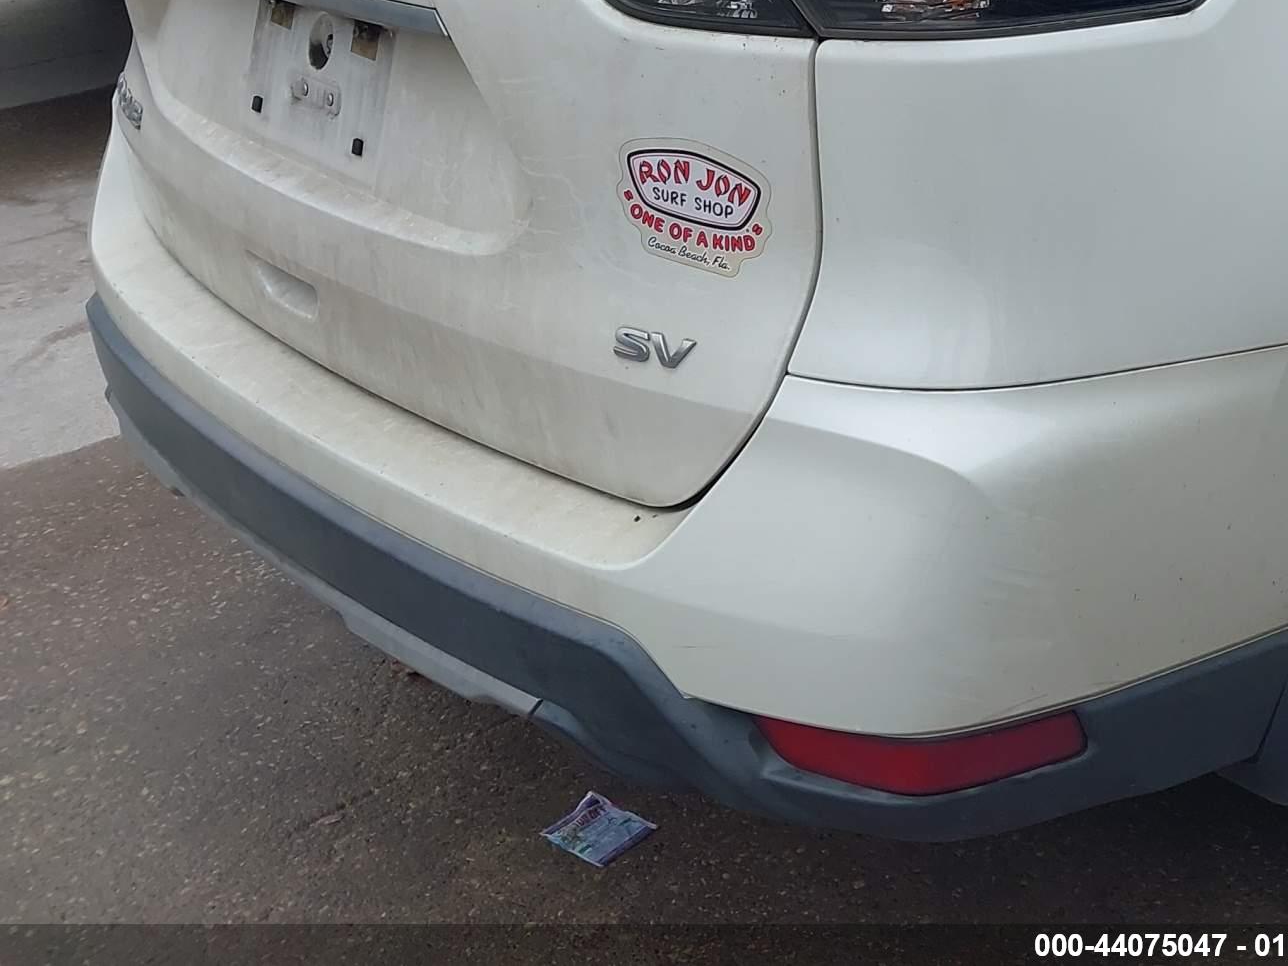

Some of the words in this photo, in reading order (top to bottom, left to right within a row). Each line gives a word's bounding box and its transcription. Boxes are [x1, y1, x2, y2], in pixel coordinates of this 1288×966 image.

[638, 159, 690, 185] RON
[696, 168, 751, 206] JON
[652, 186, 687, 207] SURF
[694, 197, 734, 219] SHOP
[648, 236, 677, 255] Cocoa
[669, 223, 693, 243] OF
[696, 231, 708, 248] A
[613, 326, 697, 369] SV
